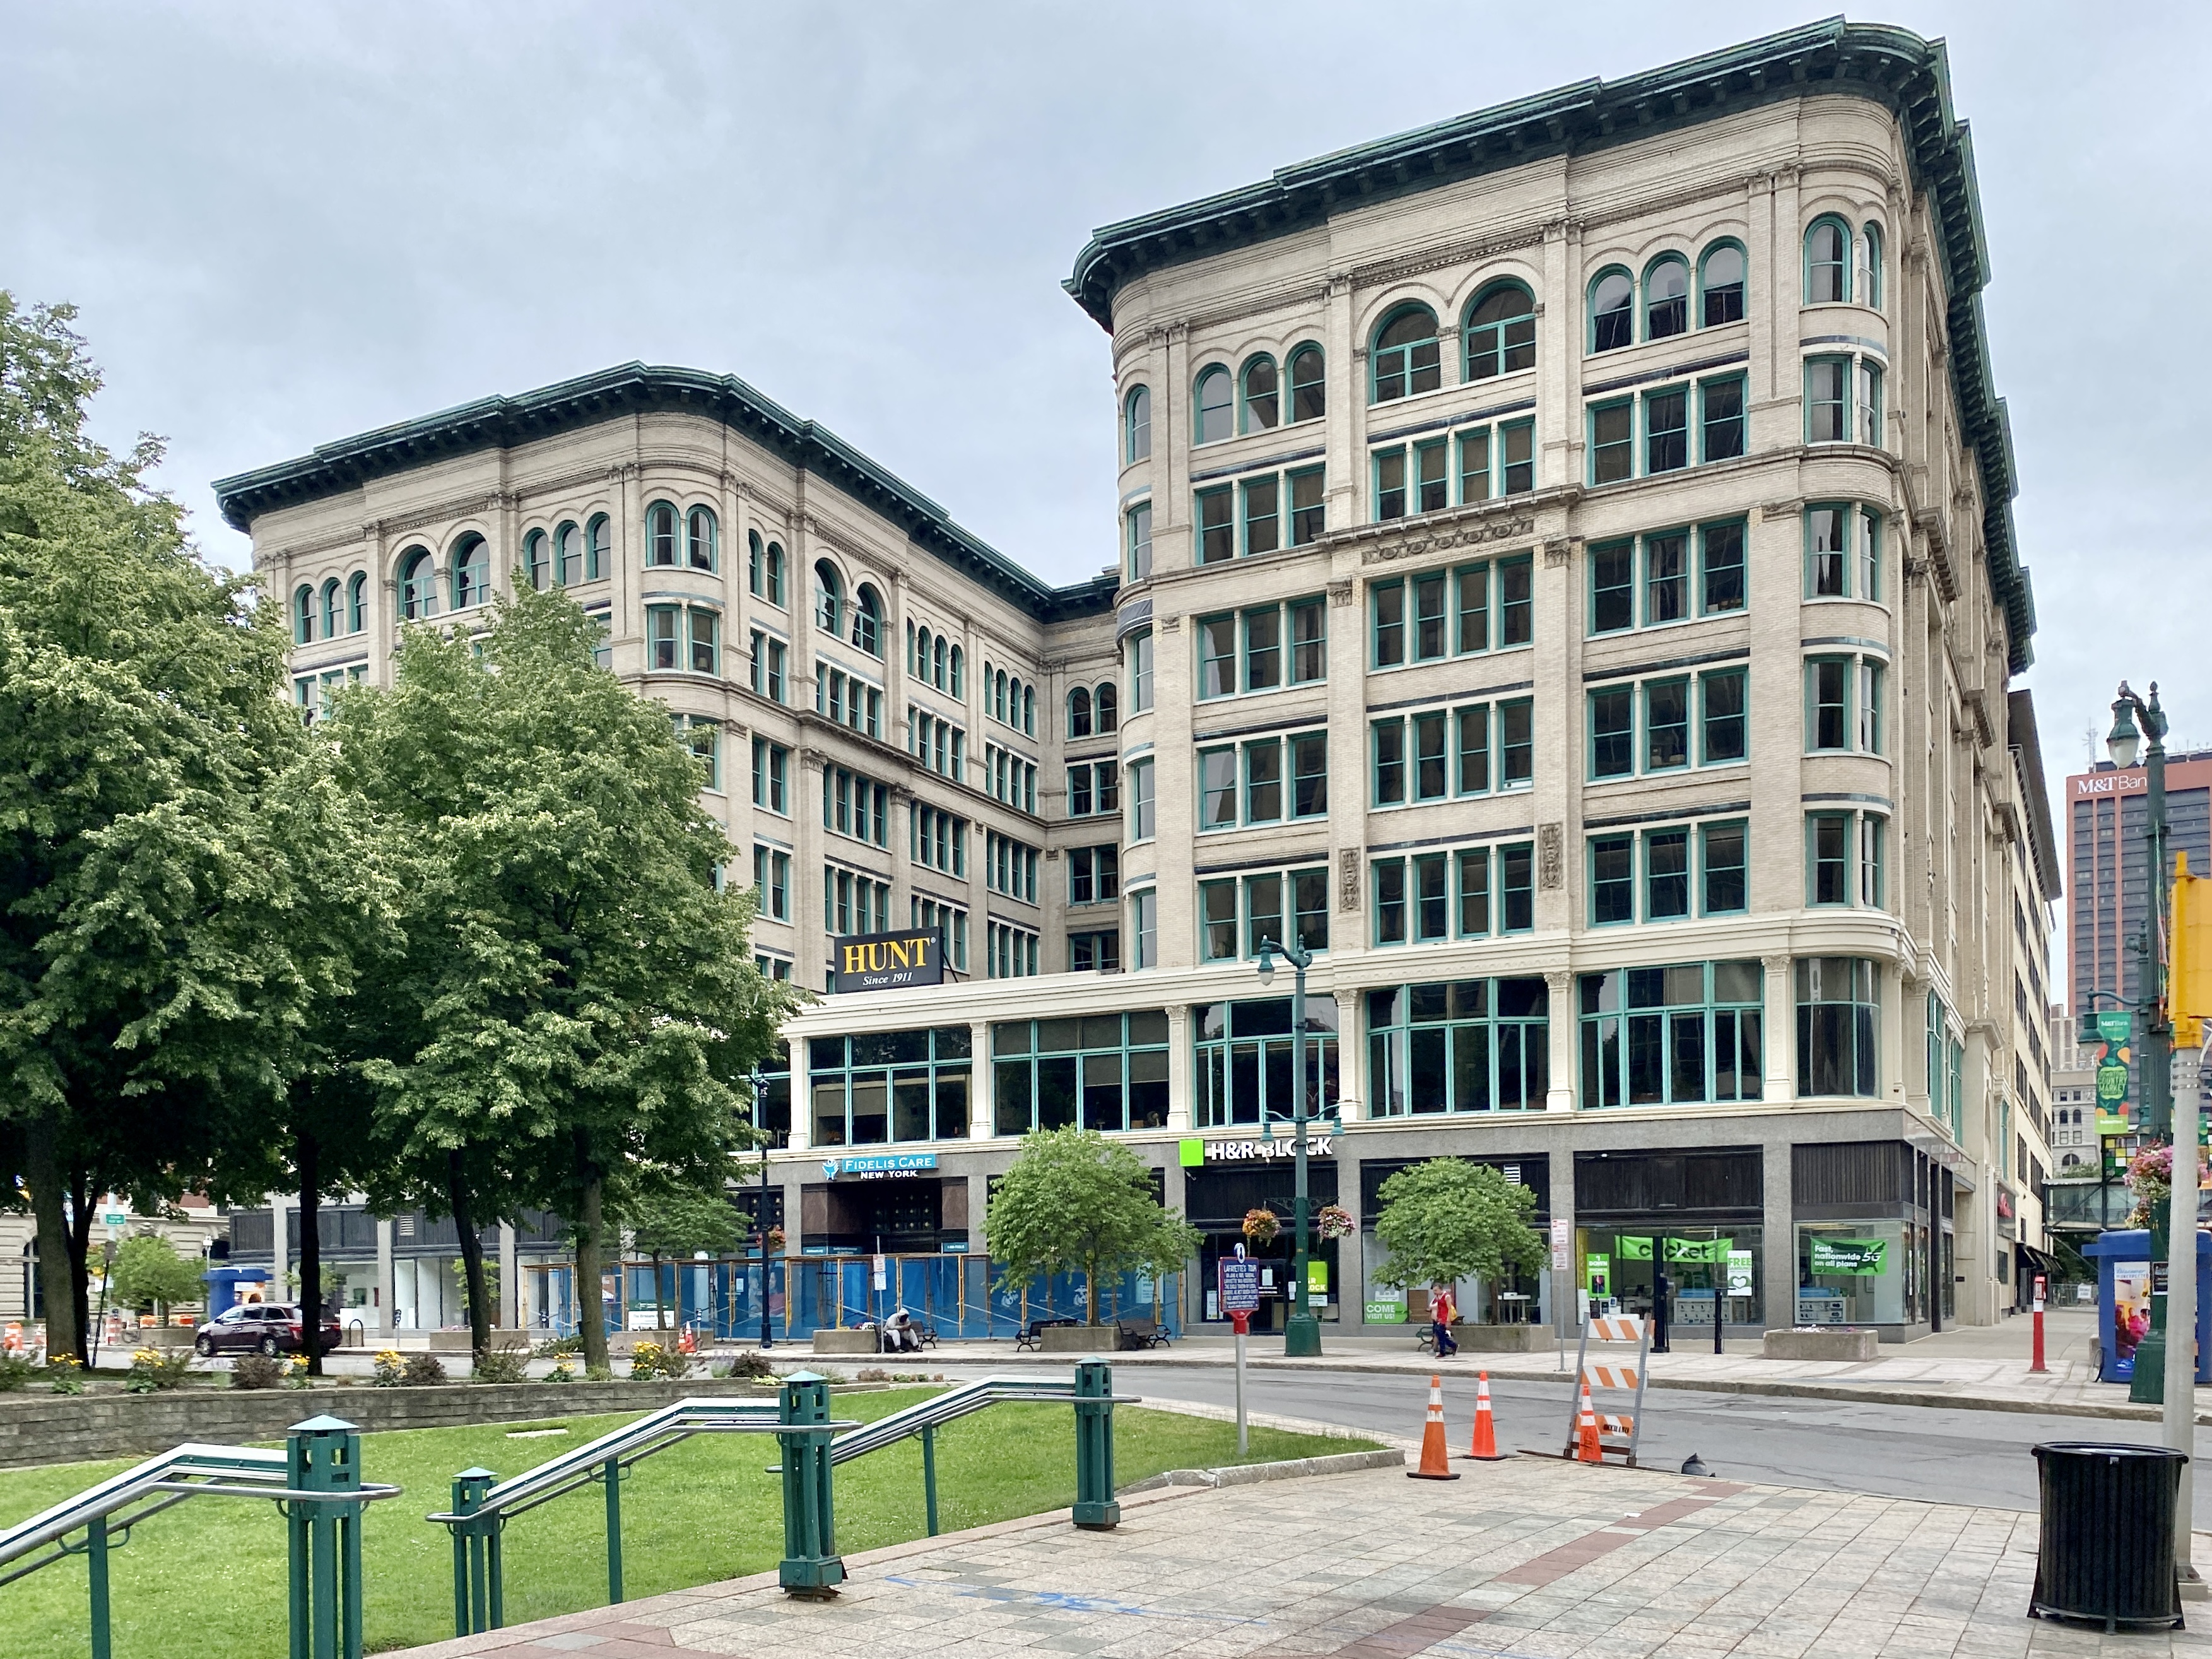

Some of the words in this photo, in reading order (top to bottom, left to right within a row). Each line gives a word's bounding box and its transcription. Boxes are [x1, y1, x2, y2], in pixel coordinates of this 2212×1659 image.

[2078, 777, 2117, 794] M&T
[2119, 776, 2147, 789] Ban
[862, 975, 888, 986] Since
[892, 972, 912, 983] 1911
[2097, 1076, 2127, 1085] COUNTRY
[2098, 1084, 2125, 1092] MARKET
[1211, 1141, 1255, 1160] H&R
[845, 1159, 895, 1170] FIDELIS
[898, 1157, 932, 1167] CARE
[861, 1171, 884, 1179] NEW
[888, 1170, 919, 1178] YORK
[1638, 1243, 1710, 1258] ccket
[1815, 1245, 1833, 1253] Fast,
[1861, 1252, 1882, 1262] 5G
[1728, 1258, 1751, 1266] FREE
[1366, 1304, 1395, 1313] COME
